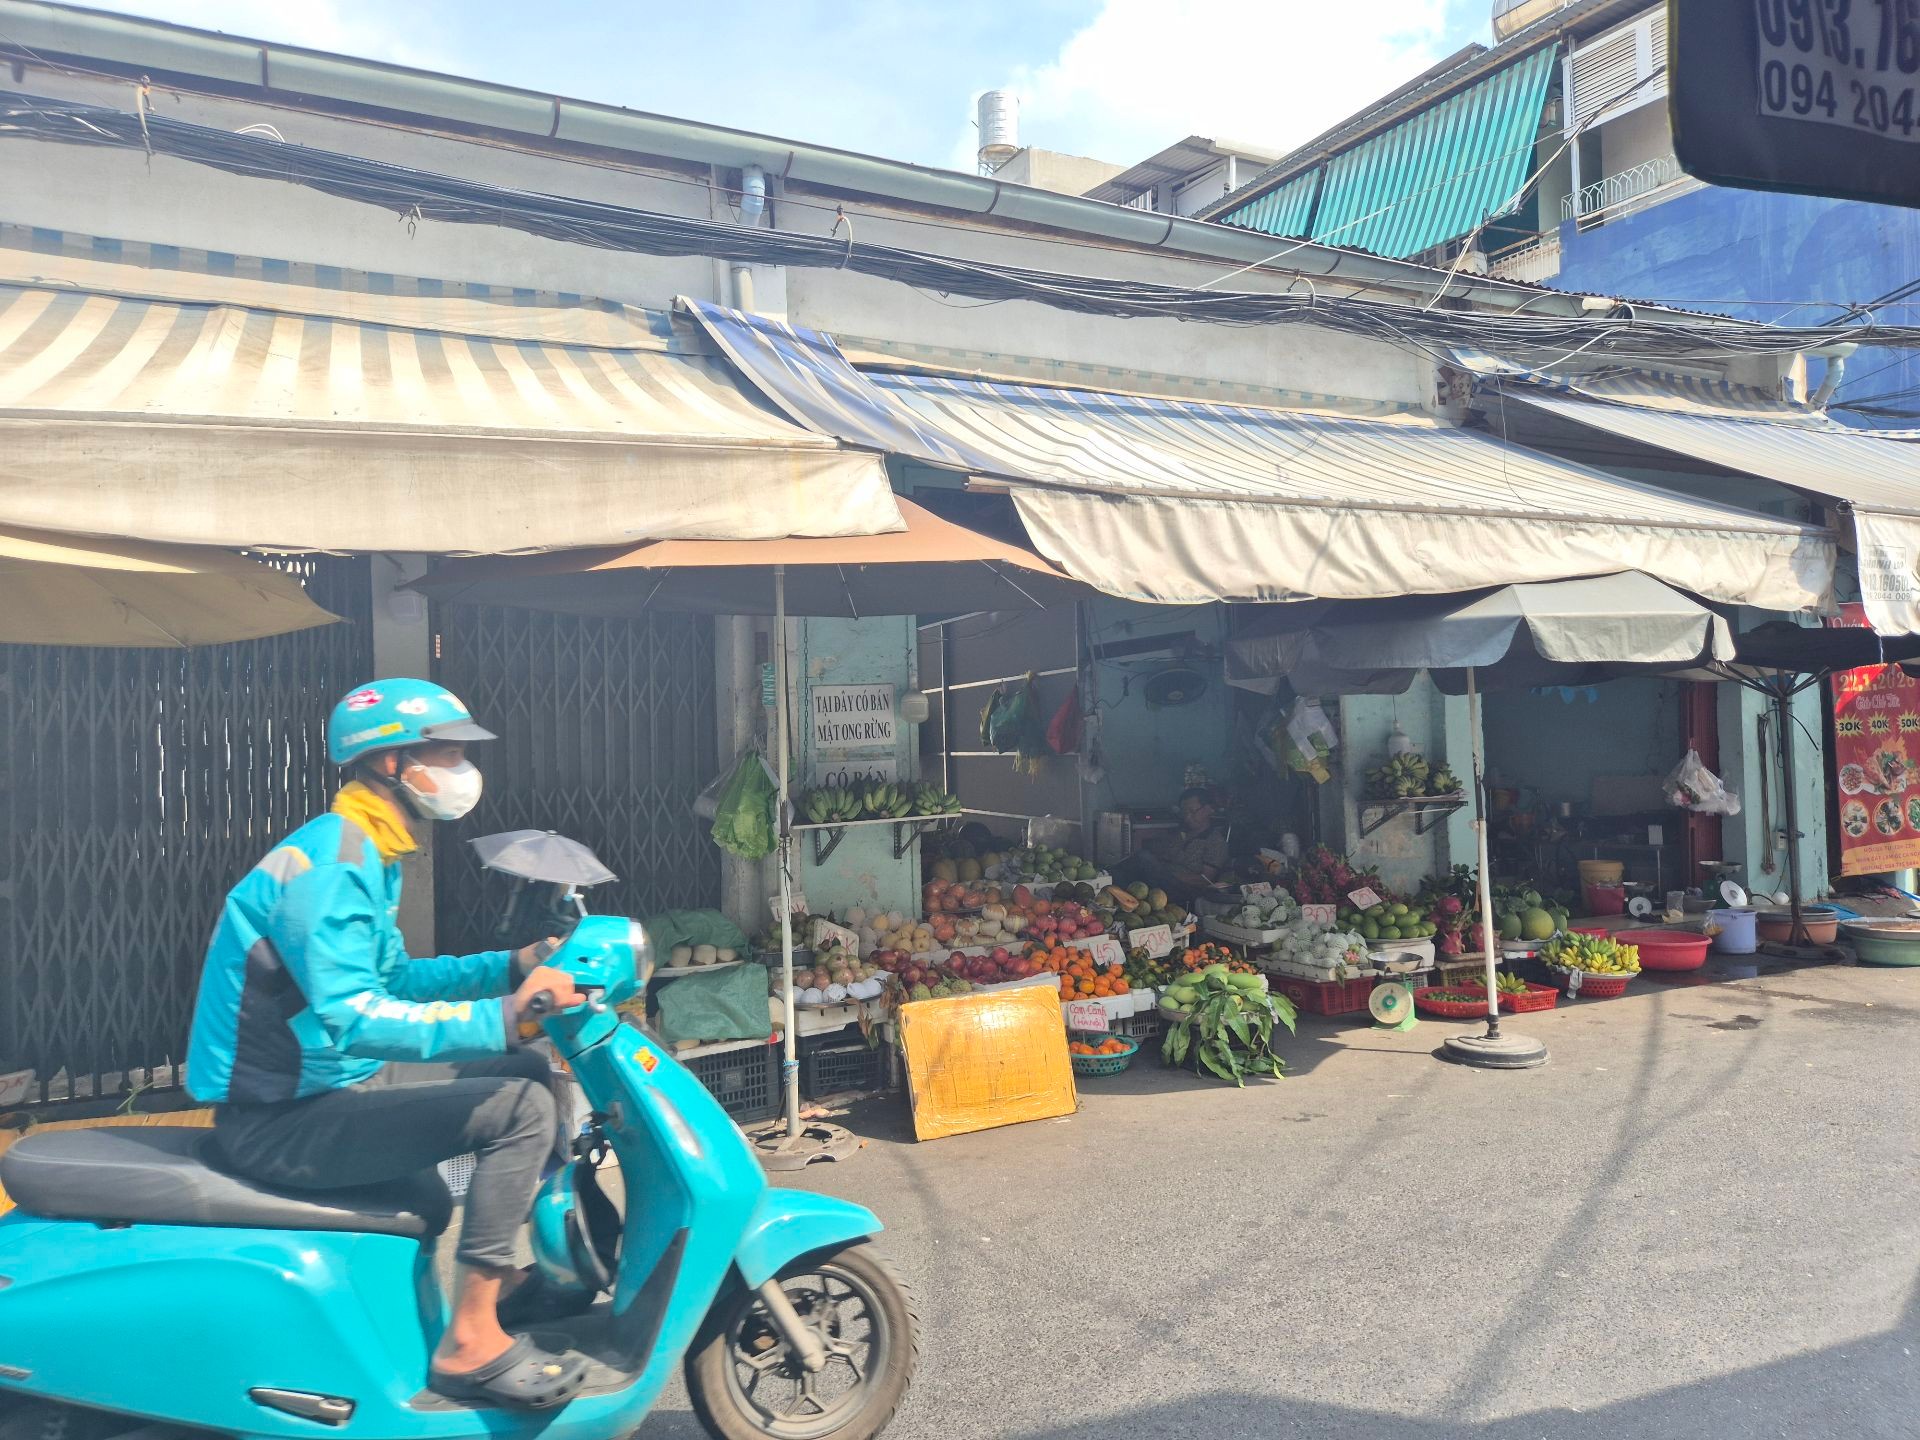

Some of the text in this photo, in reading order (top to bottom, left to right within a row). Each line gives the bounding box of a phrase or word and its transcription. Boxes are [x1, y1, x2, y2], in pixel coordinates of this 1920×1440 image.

[1763, 60, 1838, 118] 094
[816, 689, 890, 716] TẠI ĐÂY CÓ BÁN
[817, 717, 891, 744] MẬT ONG RỪNG
[1839, 718, 1918, 732] 30K 40K 50K
